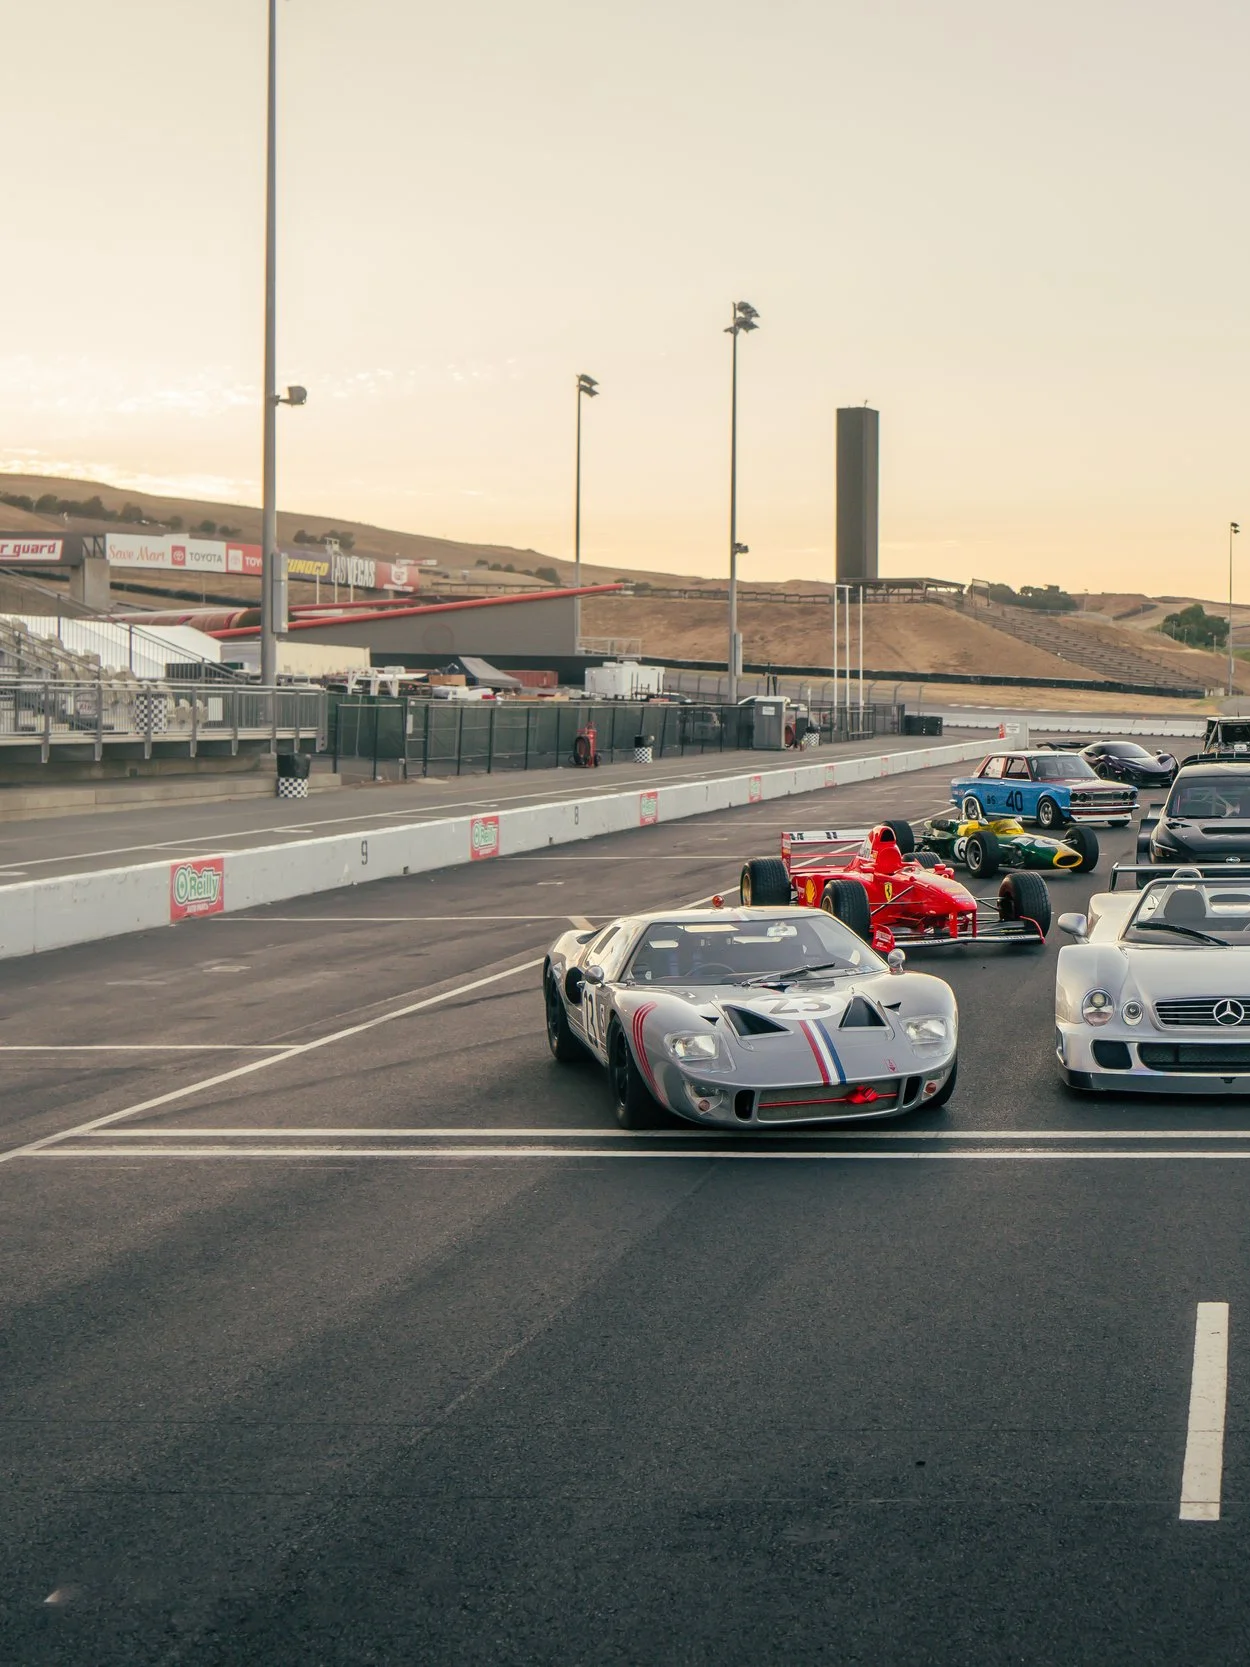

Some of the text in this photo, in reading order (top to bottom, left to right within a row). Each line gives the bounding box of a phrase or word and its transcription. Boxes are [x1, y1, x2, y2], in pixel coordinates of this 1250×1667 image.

[13, 543, 56, 557] guard
[109, 544, 166, 562] Save Mart
[189, 552, 222, 563] TOYOTA
[245, 556, 263, 567] TOY
[331, 555, 375, 587] LAS VEGAS
[1005, 790, 1024, 812] 40
[360, 839, 369, 866] 9
[175, 865, 221, 904] O'Reilly
[760, 996, 832, 1015] 23
